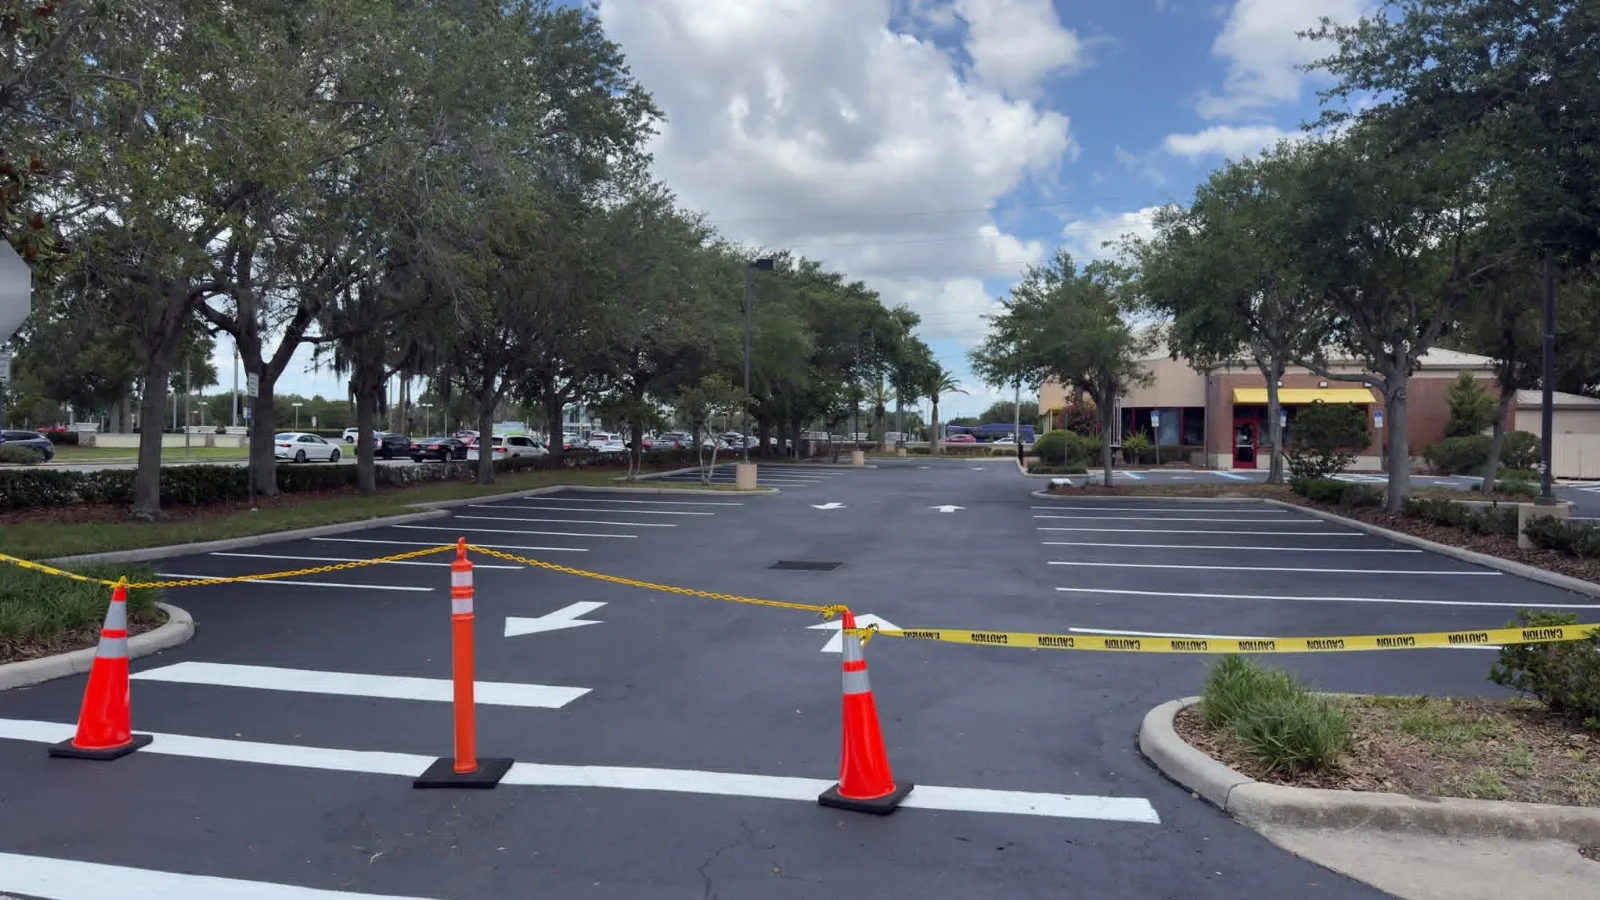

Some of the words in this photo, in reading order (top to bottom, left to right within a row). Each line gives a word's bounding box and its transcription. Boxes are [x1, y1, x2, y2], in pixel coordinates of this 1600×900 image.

[971, 633, 1008, 644] CAUTION
[1448, 633, 1488, 644] CAUTION
[1522, 628, 1563, 640] CAUTION
[1038, 636, 1074, 647] CAUTION
[1104, 639, 1141, 650] CAUTION
[1171, 640, 1207, 651] CAUTION
[1238, 641, 1276, 651] CAUTION
[1306, 639, 1345, 649] CAUTION
[1376, 636, 1415, 647] CAUTION
